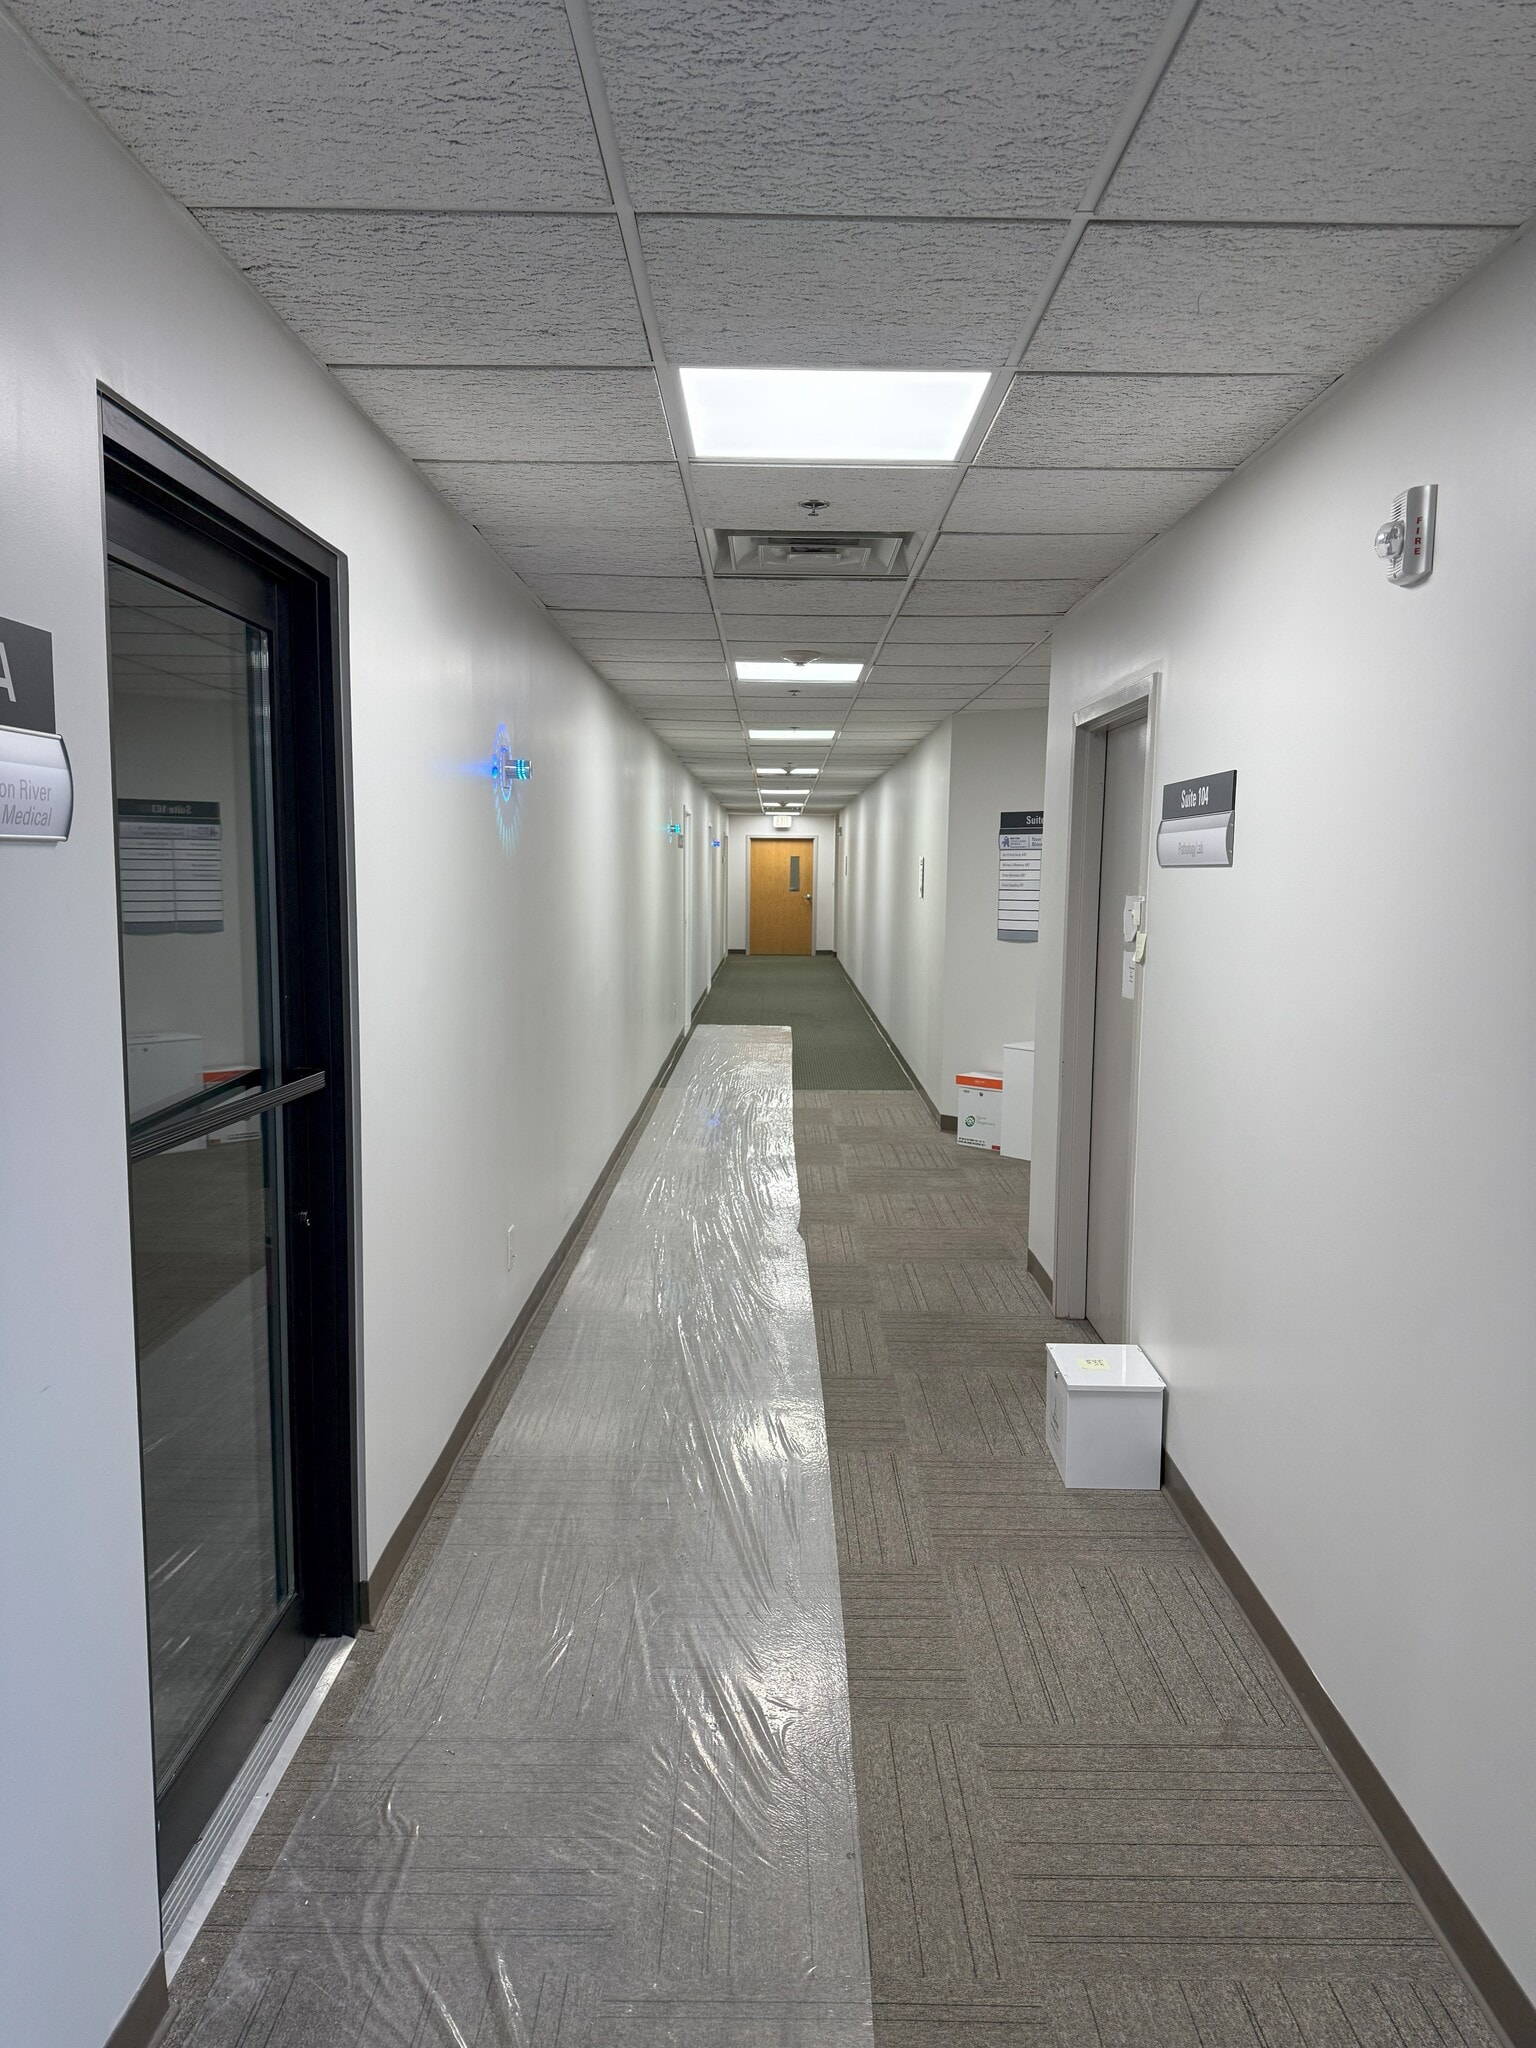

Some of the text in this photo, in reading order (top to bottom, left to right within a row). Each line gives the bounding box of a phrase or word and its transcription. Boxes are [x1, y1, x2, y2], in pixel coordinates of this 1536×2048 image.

[1414, 516, 1423, 555] FIRE
[20, 779, 52, 801] River
[1181, 786, 1209, 808] Suite 104
[2, 804, 53, 826] Medical
